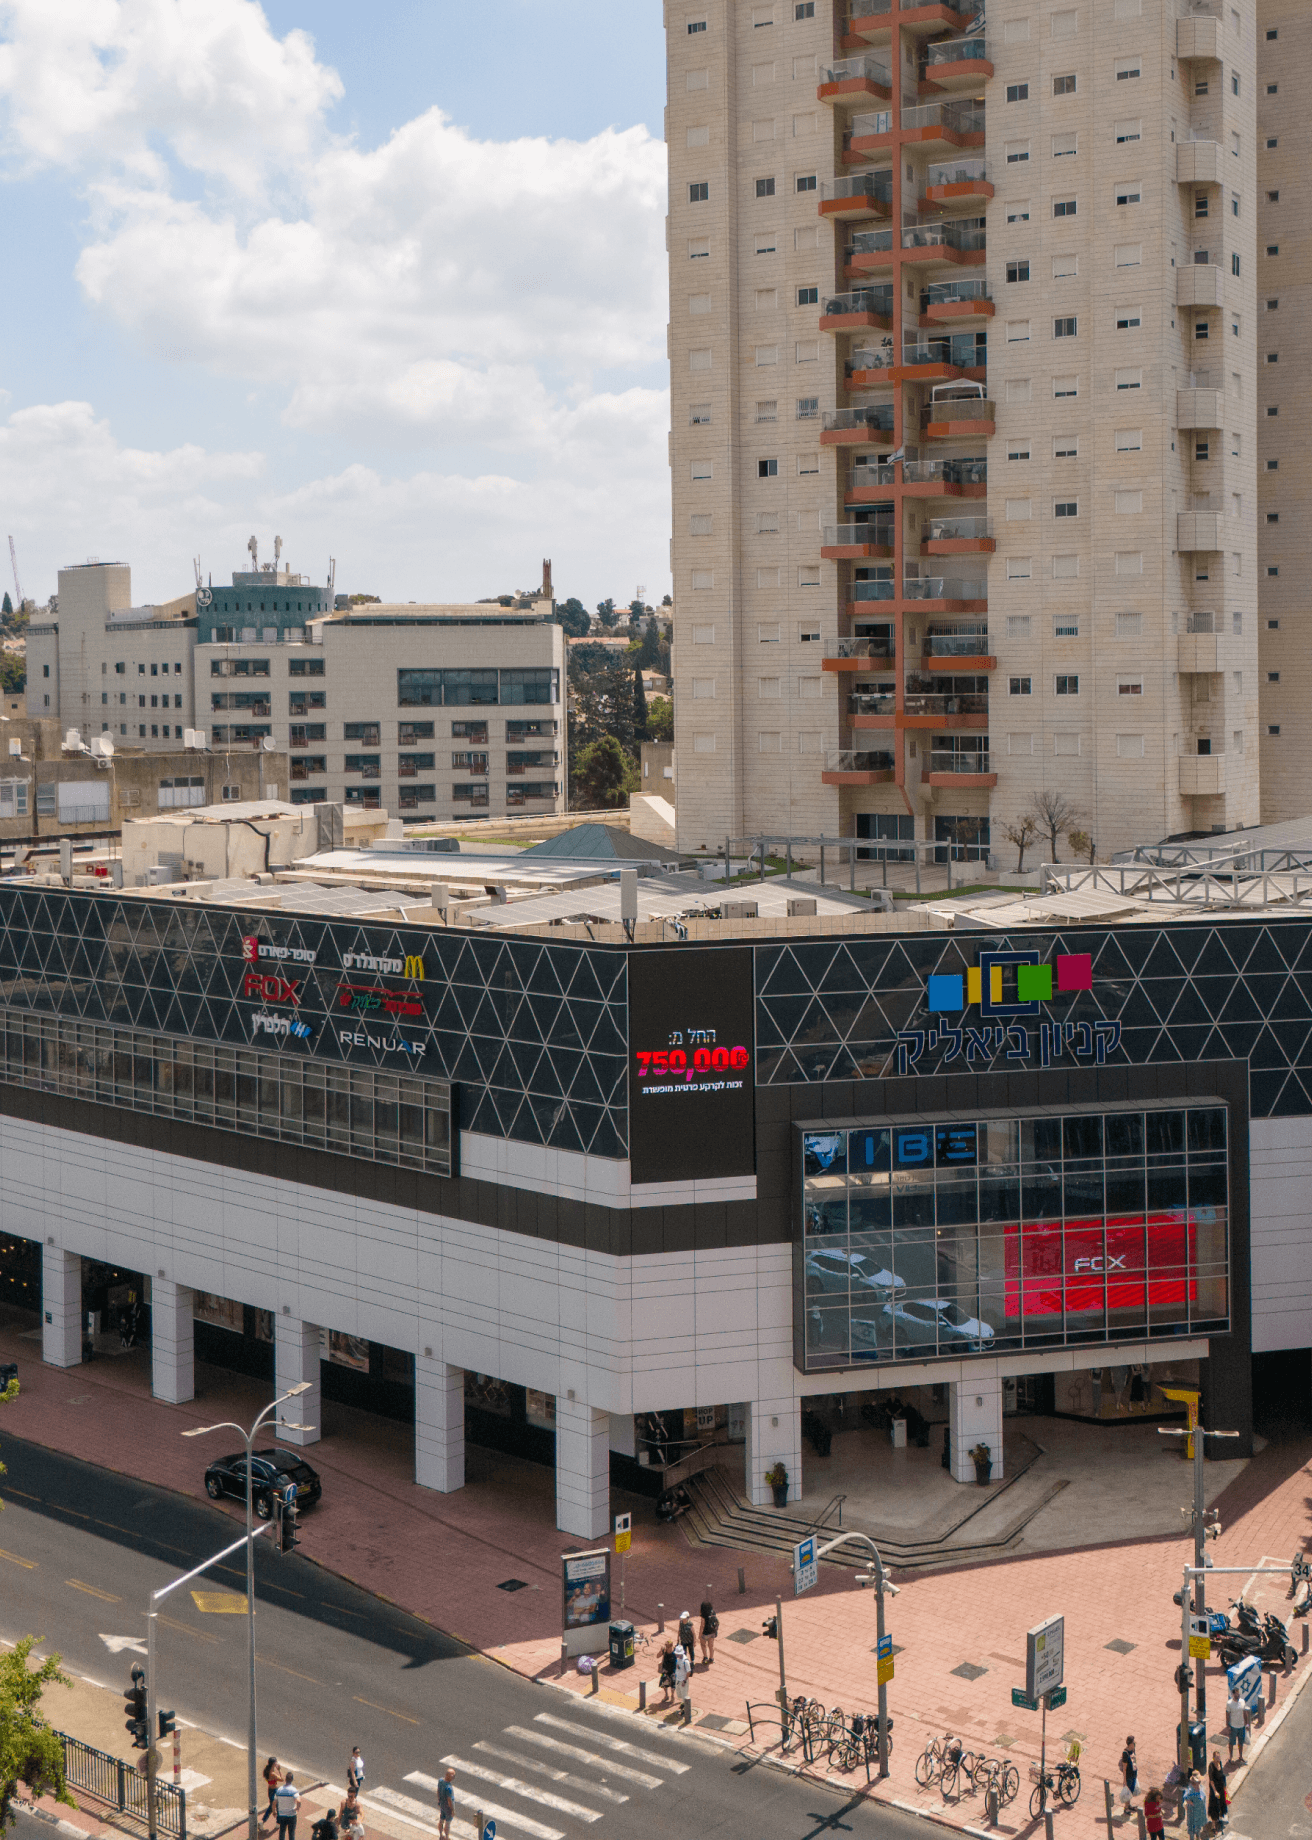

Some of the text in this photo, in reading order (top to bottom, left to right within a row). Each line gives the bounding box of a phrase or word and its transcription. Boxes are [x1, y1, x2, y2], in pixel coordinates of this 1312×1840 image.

[258, 944, 317, 962] סופר-פארם
[244, 973, 301, 1005] FOX
[687, 1028, 716, 1044] החל
[340, 1031, 426, 1056] RENUAR
[896, 1018, 1122, 1075] קניון ביאליק
[674, 1082, 698, 1092] פרטית
[699, 1080, 725, 1091] לקרקע
[726, 1080, 743, 1089] זכות
[698, 1407, 713, 1415] POP
[698, 1415, 713, 1425] UP
[1295, 1563, 1309, 1577] 34
